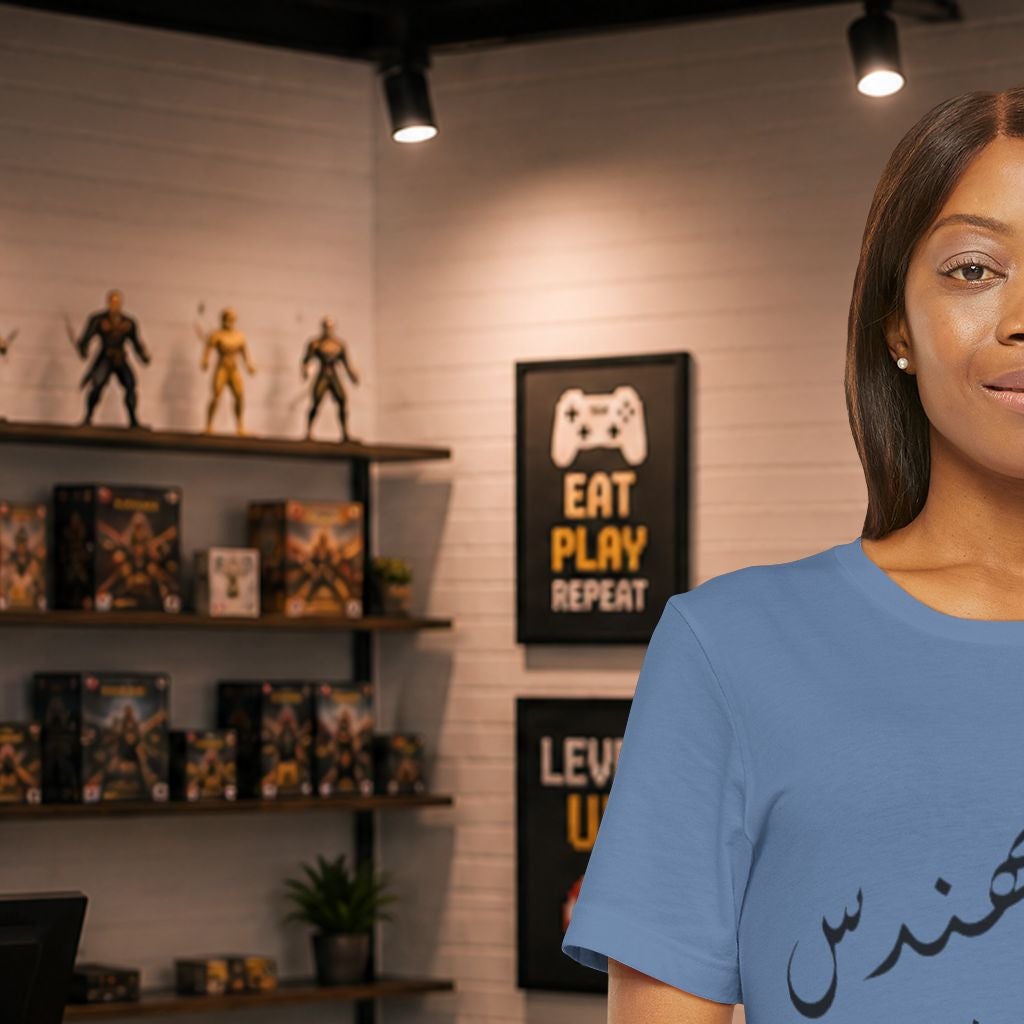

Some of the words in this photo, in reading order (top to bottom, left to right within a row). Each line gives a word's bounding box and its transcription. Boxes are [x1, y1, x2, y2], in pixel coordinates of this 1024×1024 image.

[563, 471, 636, 519] EAT
[551, 526, 647, 572] PLAY
[551, 578, 647, 612] REPEAT
[566, 793, 609, 852] U
